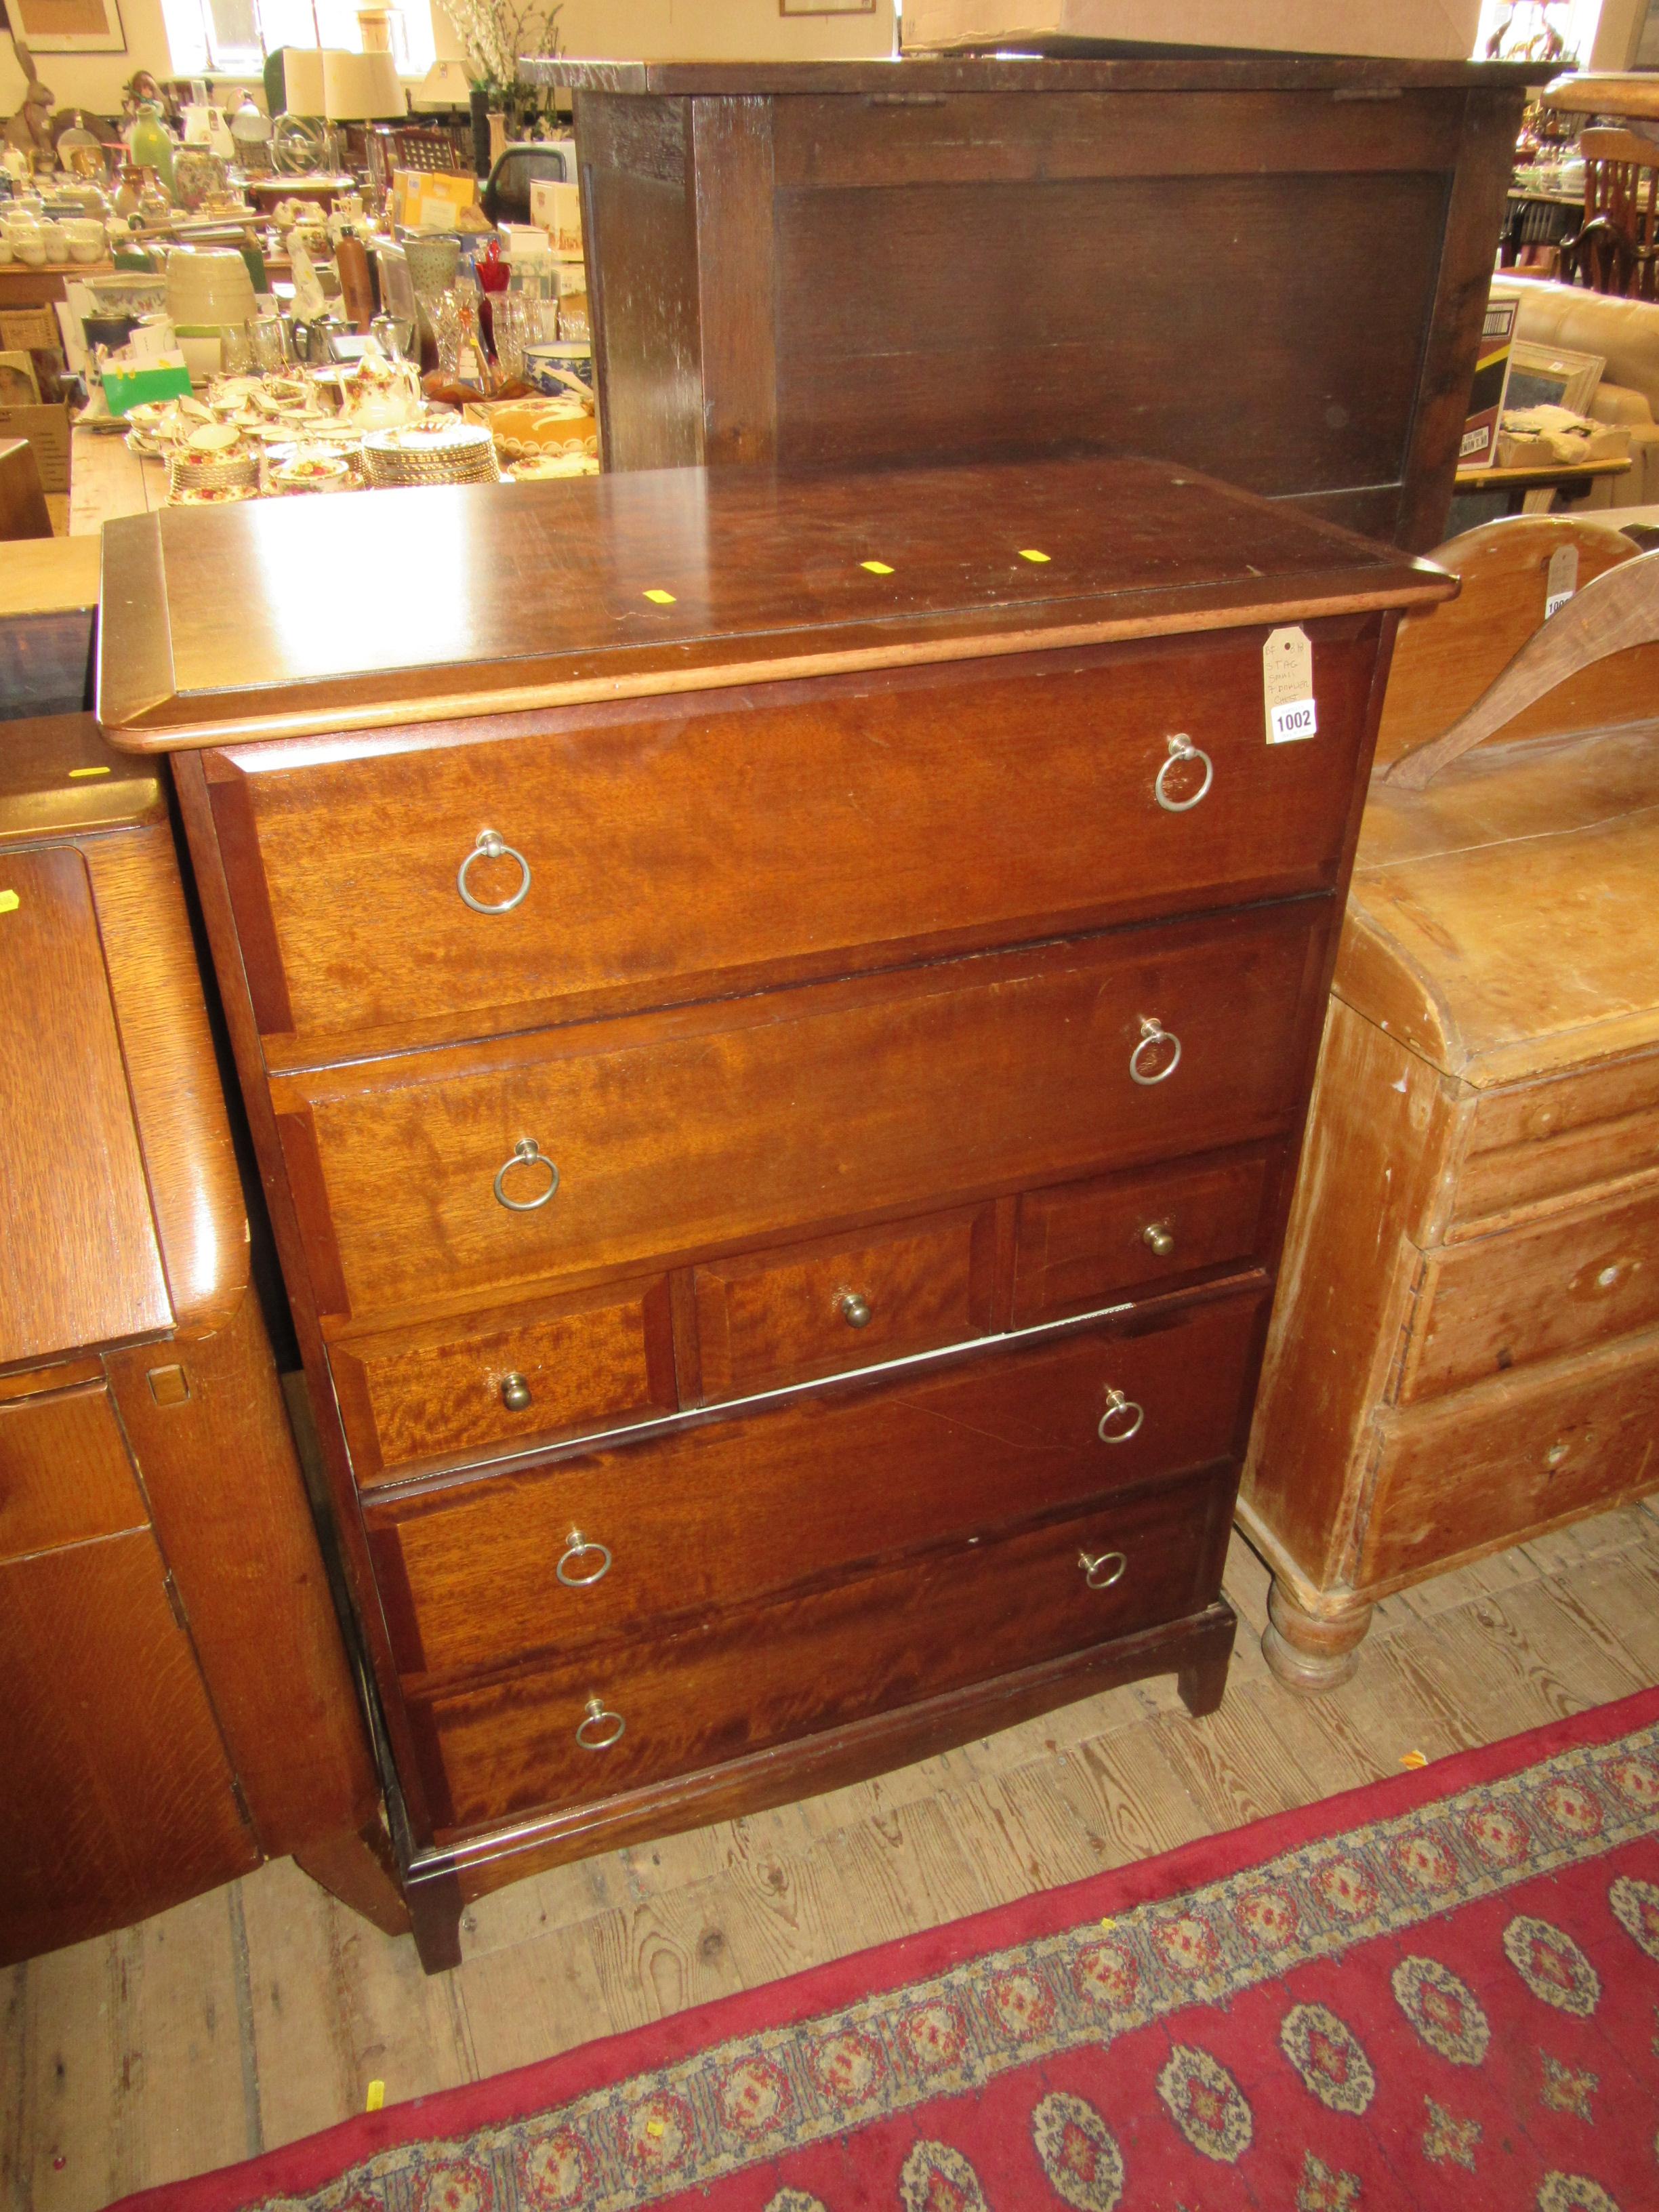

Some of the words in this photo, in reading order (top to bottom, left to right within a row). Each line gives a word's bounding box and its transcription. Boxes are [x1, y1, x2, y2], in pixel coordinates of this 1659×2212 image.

[1549, 600, 1570, 613] 100
[1266, 660, 1298, 670] STAG
[1274, 694, 1299, 705] CHEST
[1277, 710, 1311, 733] 1002
